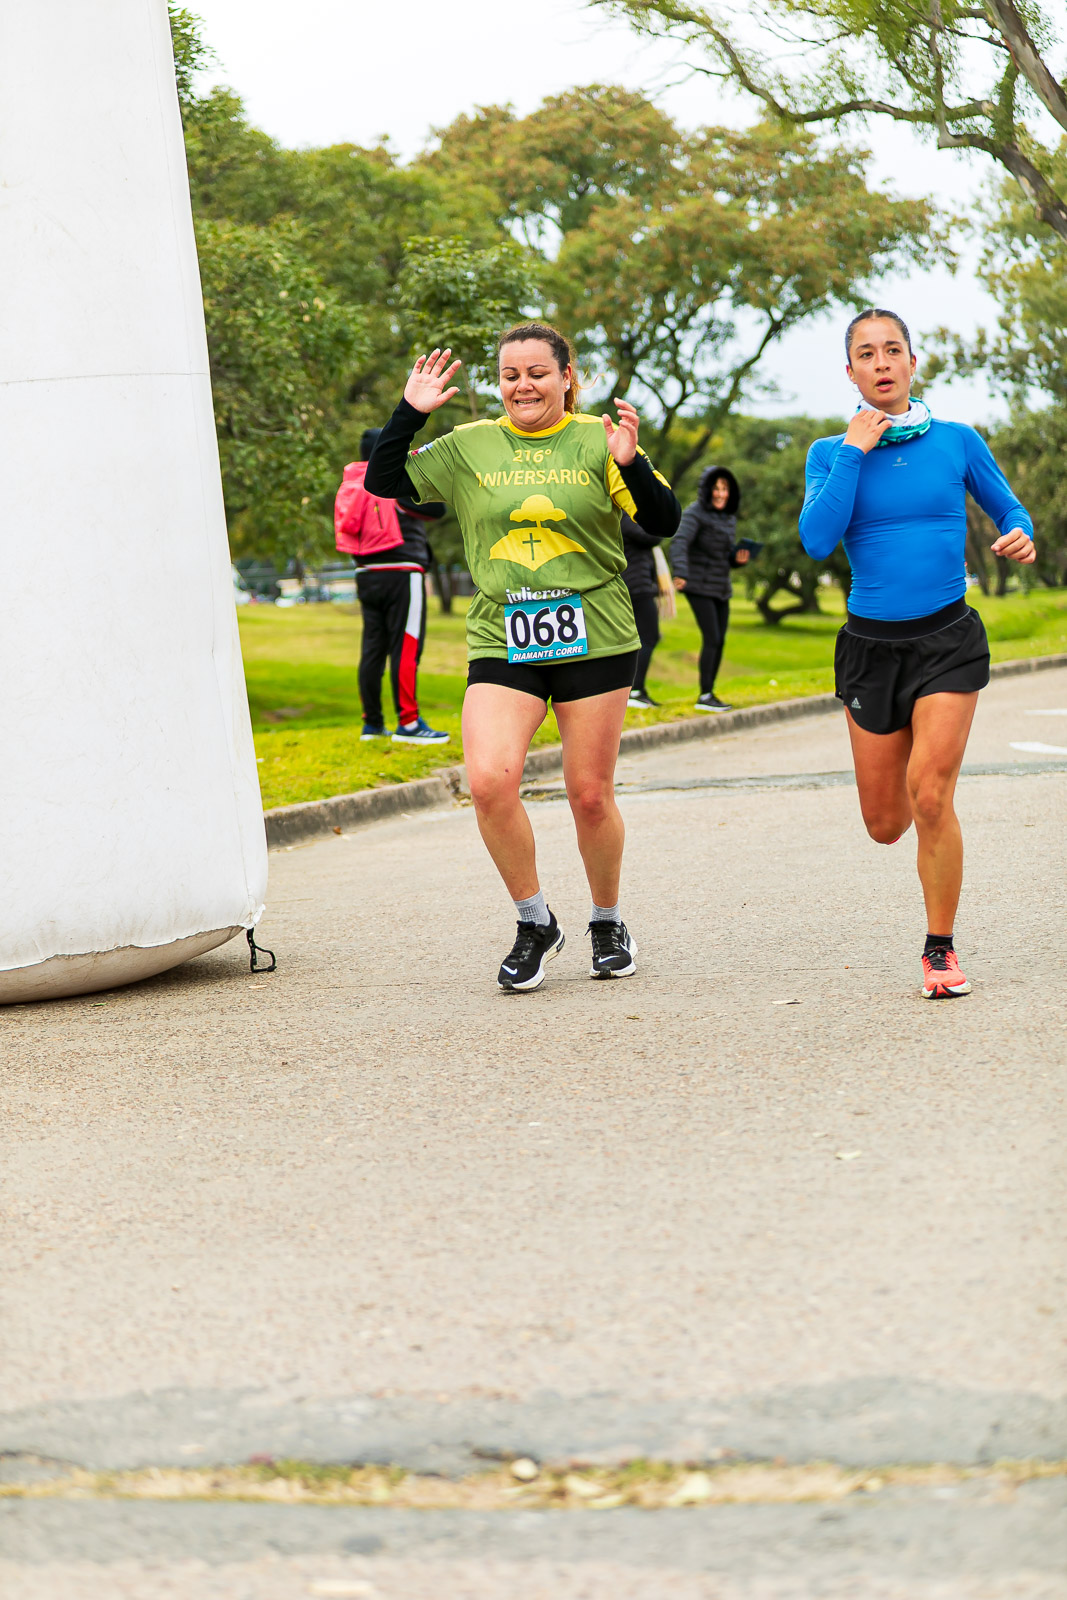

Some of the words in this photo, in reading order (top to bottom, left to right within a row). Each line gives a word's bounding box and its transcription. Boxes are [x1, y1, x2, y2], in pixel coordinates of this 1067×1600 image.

[512, 448, 552, 463] 216°
[510, 603, 579, 650] 068
[512, 649, 554, 661] DIAMANTE
[555, 645, 584, 656] CORRE
